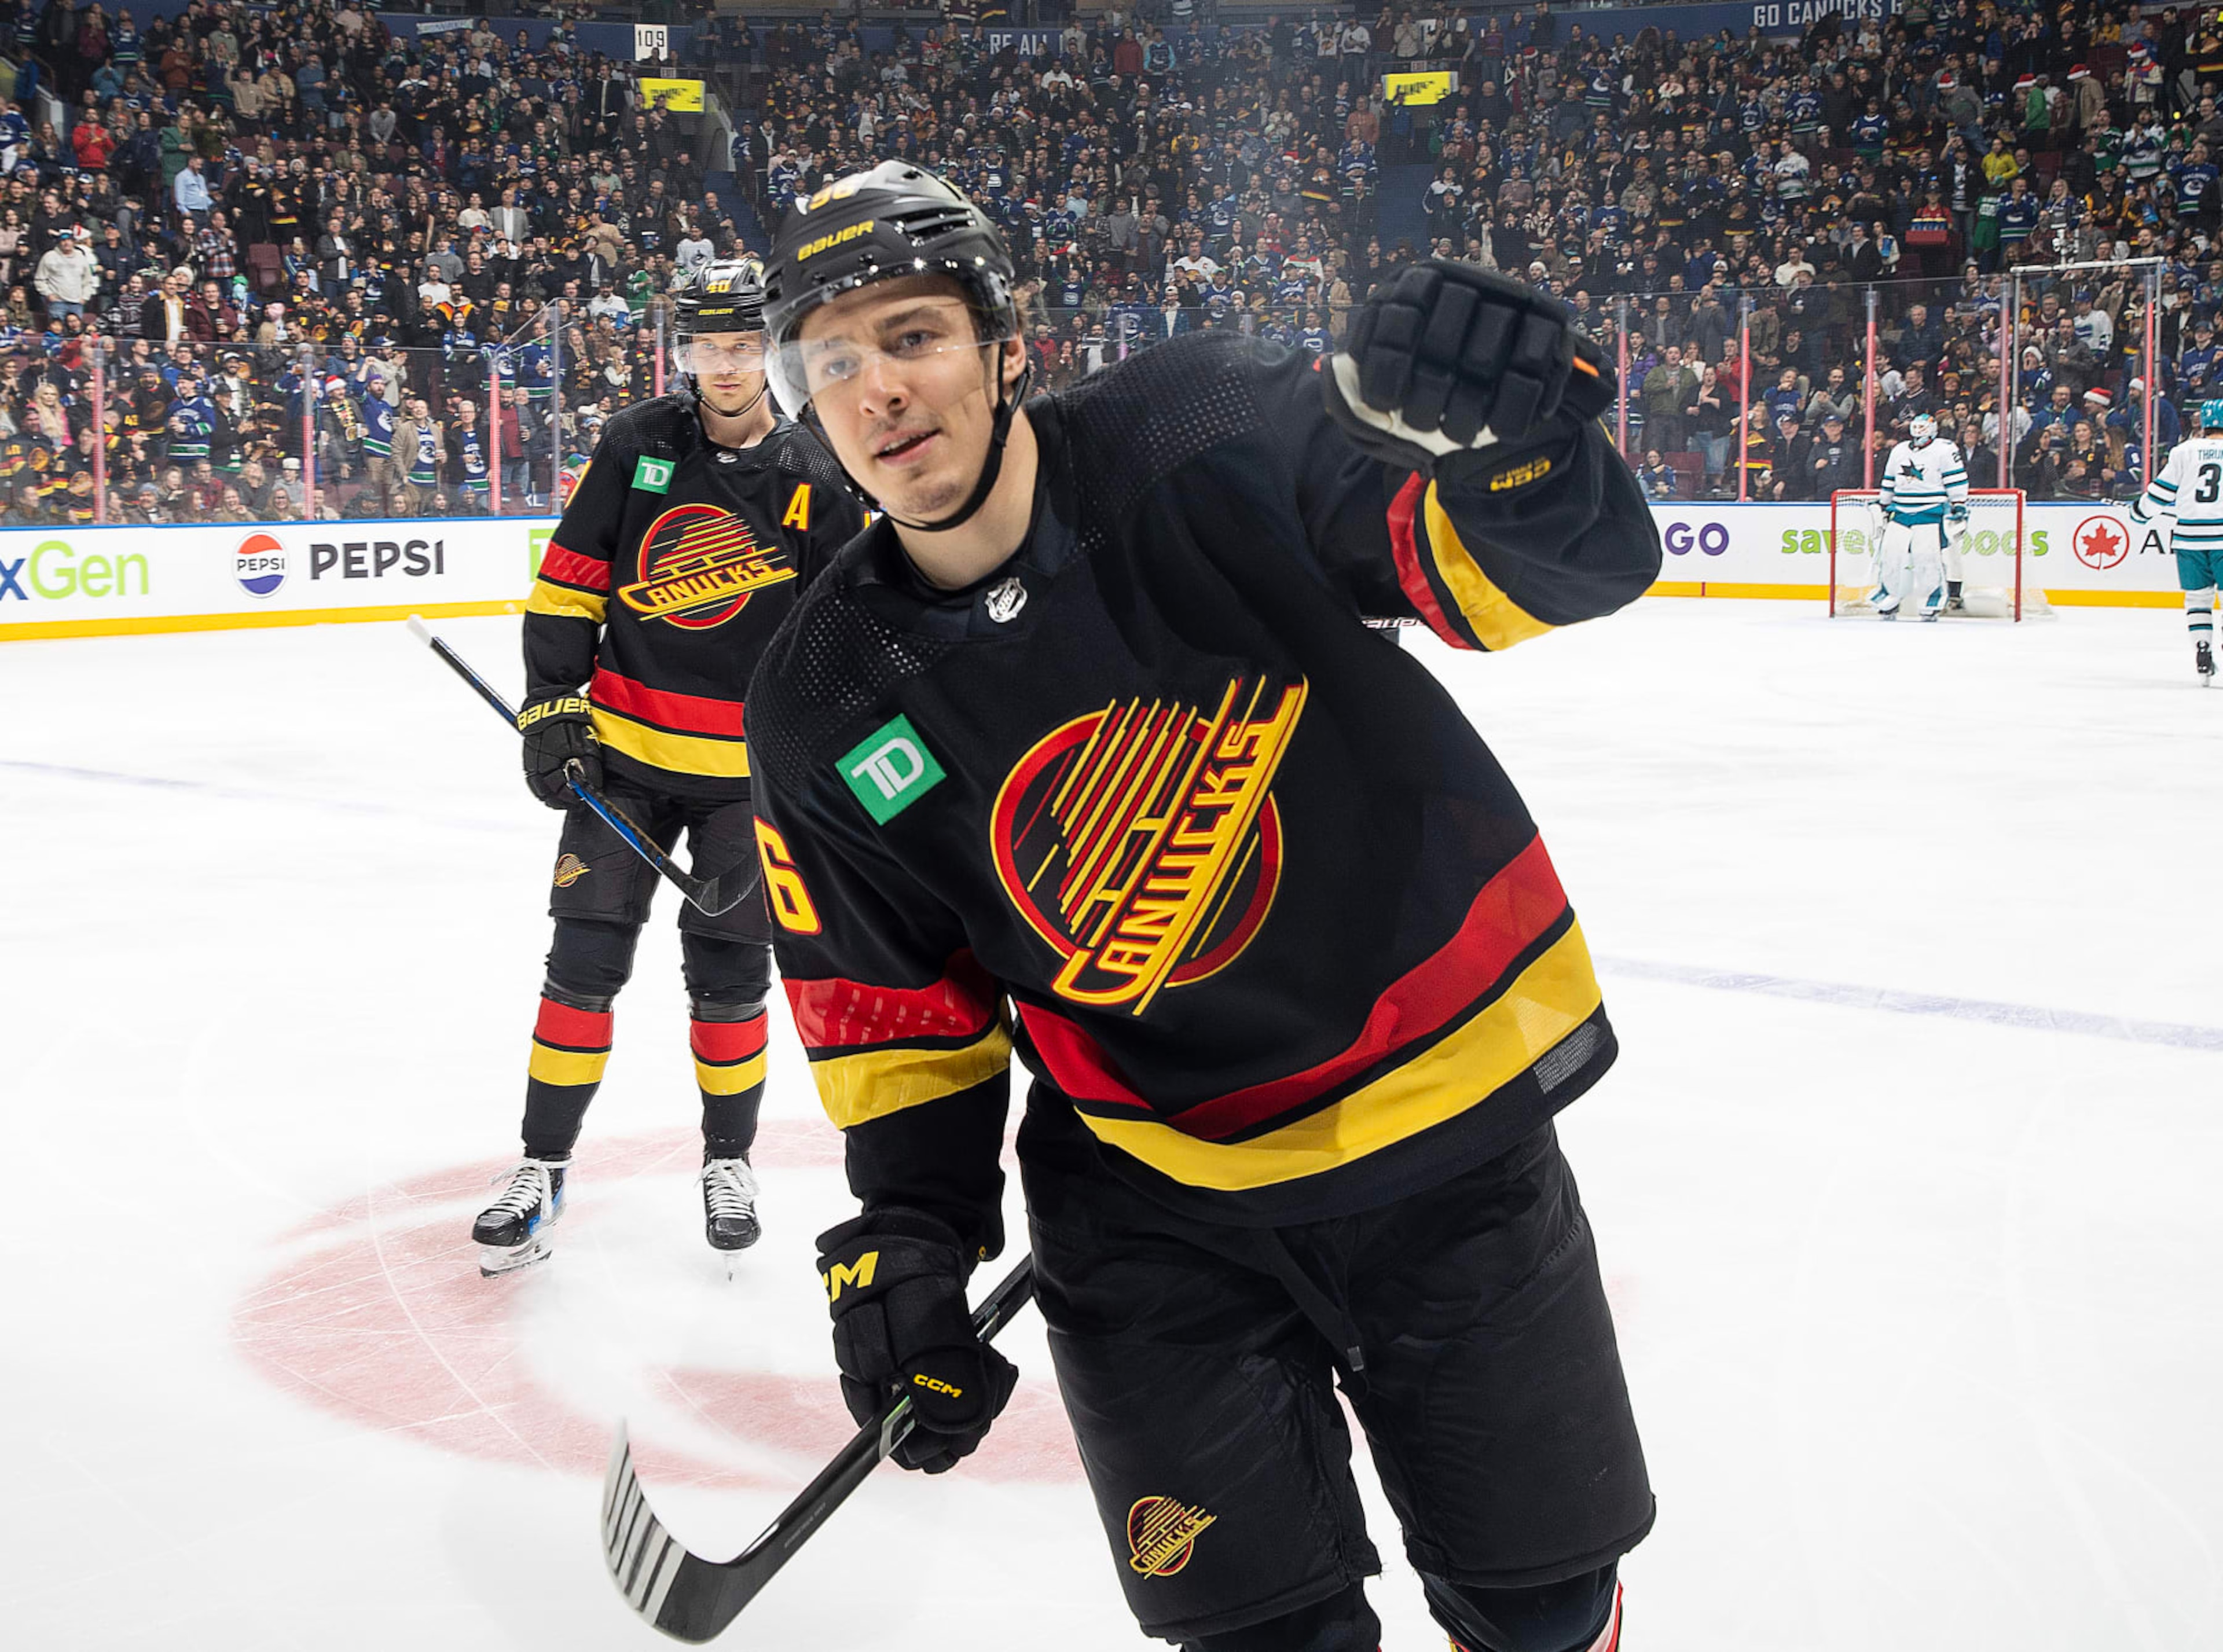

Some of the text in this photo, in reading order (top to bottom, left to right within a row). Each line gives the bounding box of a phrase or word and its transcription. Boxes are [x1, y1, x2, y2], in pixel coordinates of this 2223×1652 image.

[1754, 5, 1780, 27] GO
[638, 30, 664, 47] 109
[641, 462, 669, 486] TD
[2195, 463, 2222, 502] 3
[782, 482, 812, 531] A
[1664, 522, 1730, 556] GO
[237, 557, 285, 571] PEPSI
[310, 539, 444, 580] PEPSI
[617, 556, 798, 615] CANUCKS
[850, 737, 925, 801] TD
[1051, 682, 1304, 1006] CANUCKS
[914, 1373, 963, 1398] CCM
[1129, 1514, 1213, 1574] CANUCKS
